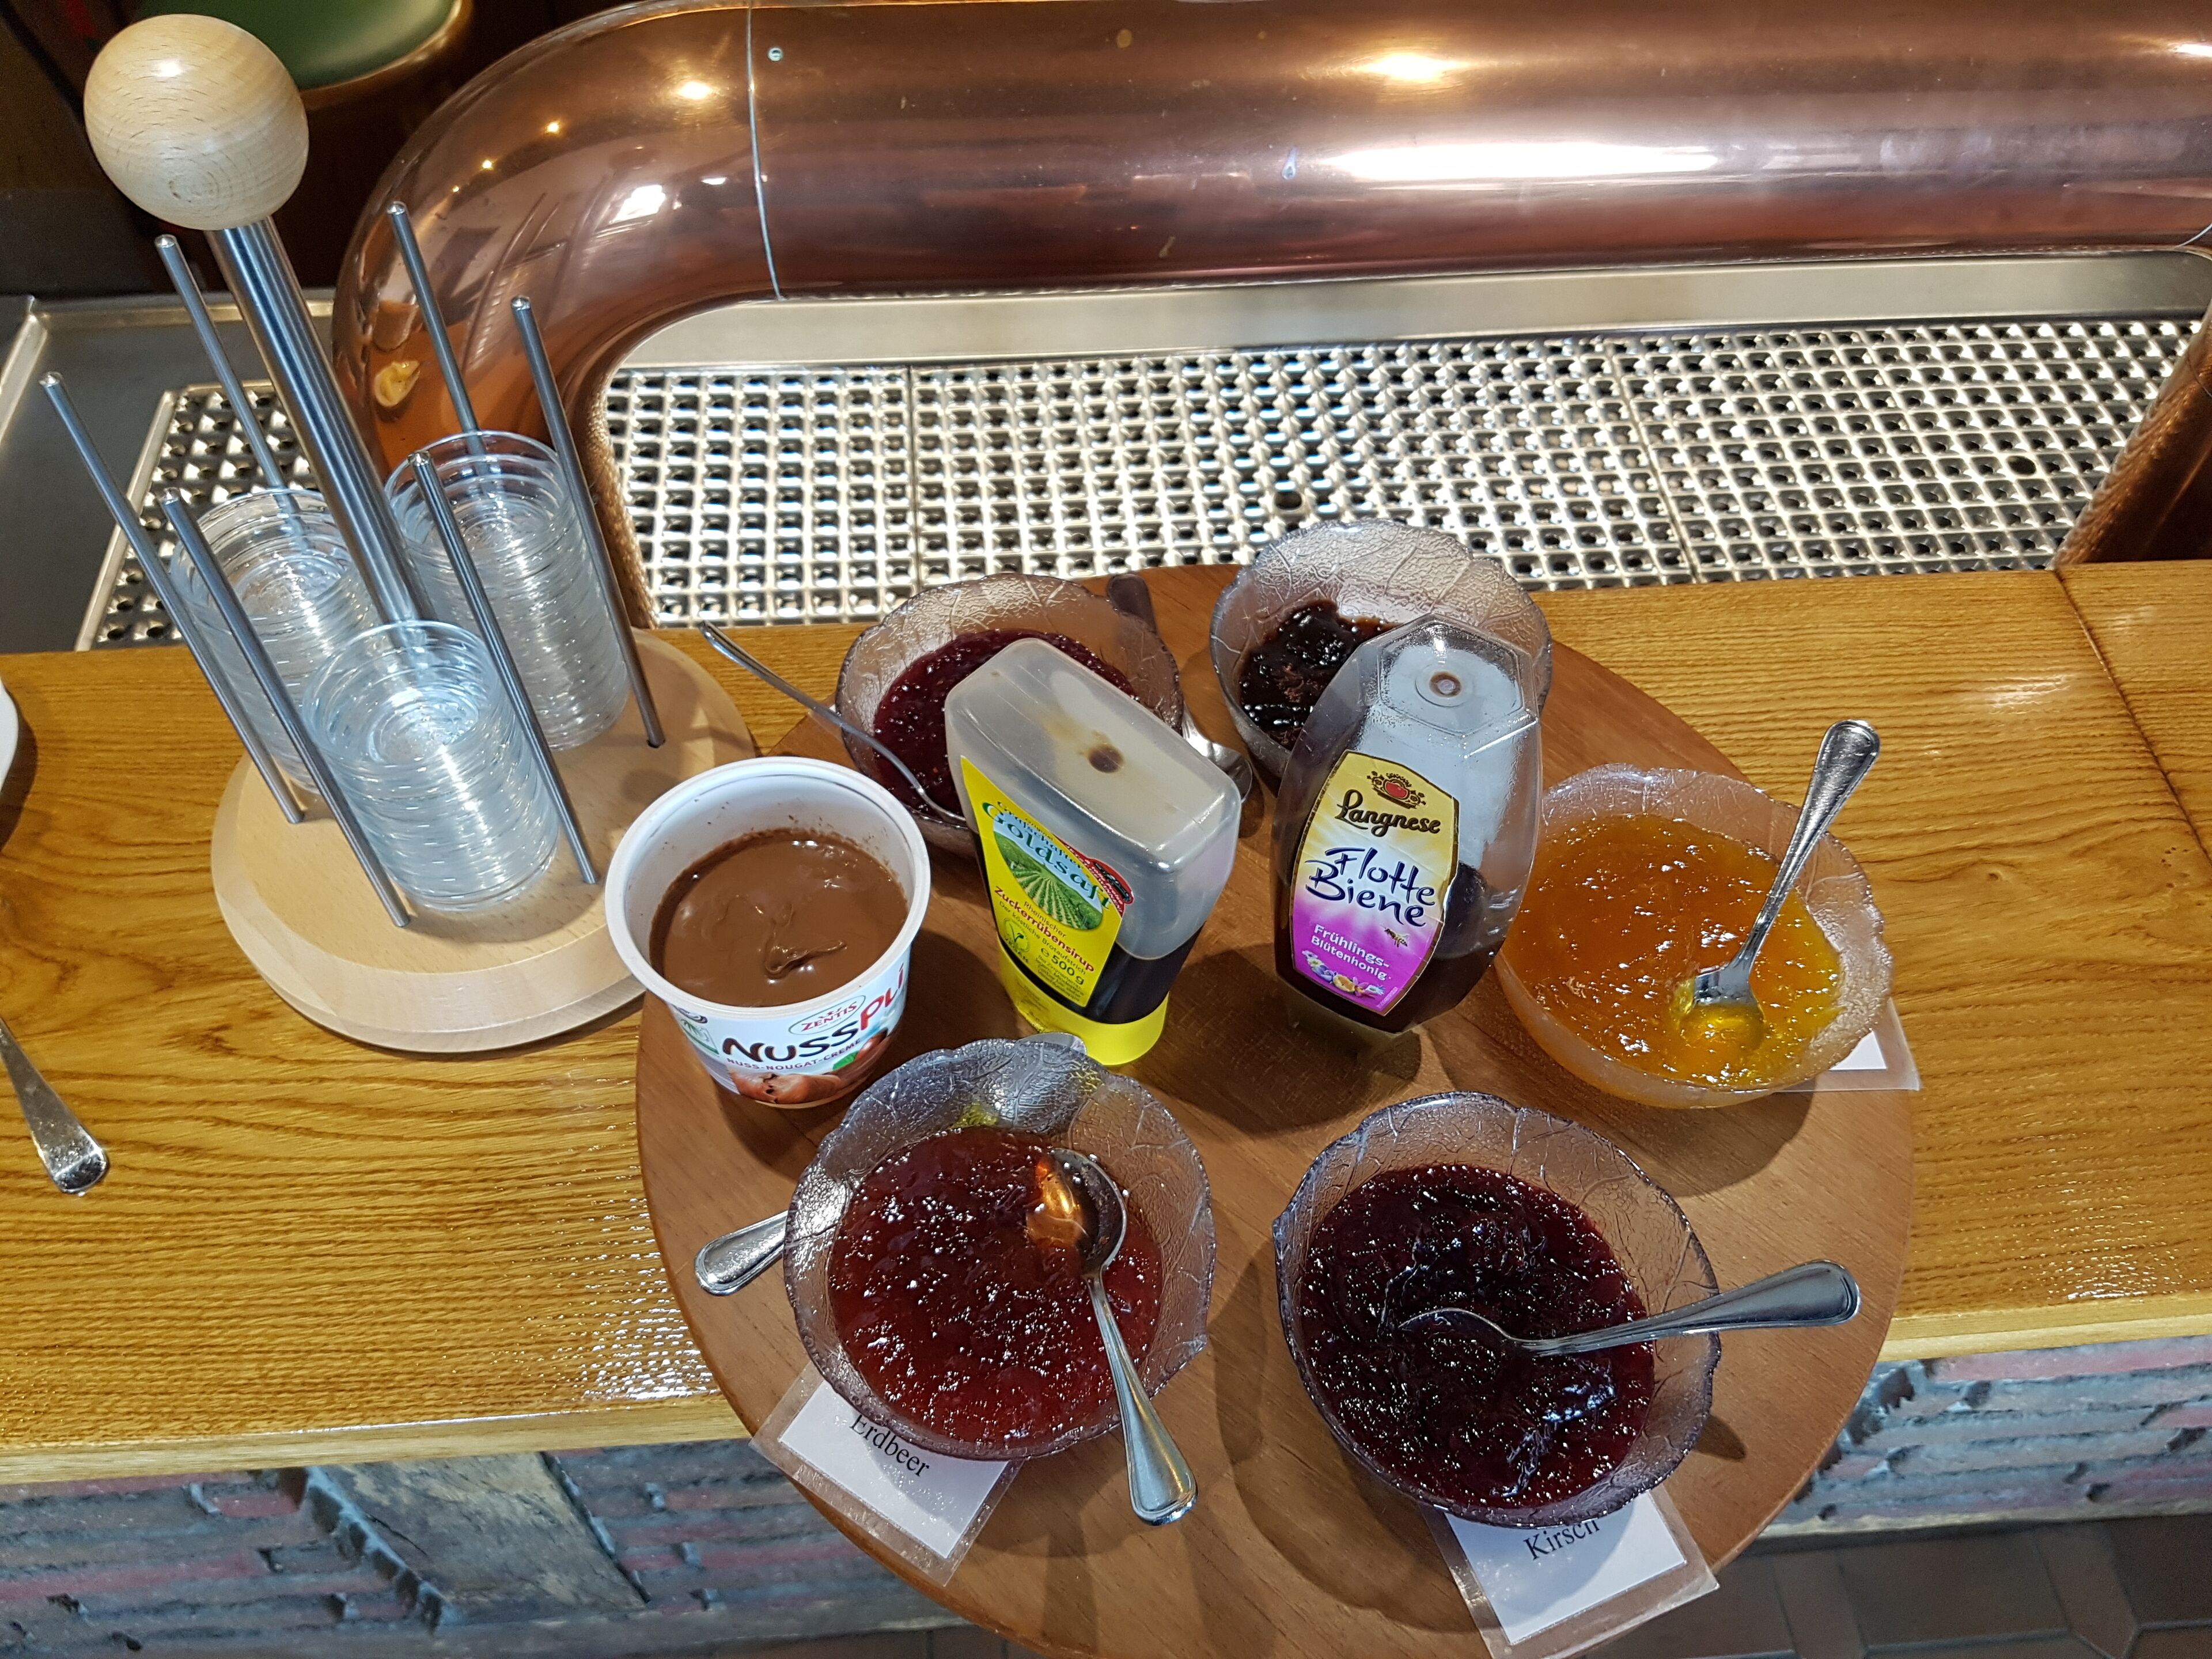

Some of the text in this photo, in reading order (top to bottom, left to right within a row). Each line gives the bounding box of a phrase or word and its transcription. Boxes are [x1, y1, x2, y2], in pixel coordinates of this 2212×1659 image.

[1335, 789, 1441, 837] Langnese
[982, 802, 1111, 910] Goldsaft
[1325, 847, 1435, 906] Flotte
[1305, 860, 1426, 927] Biene
[994, 886, 1094, 972] Zuckerrübensirup
[999, 901, 1086, 975] Der köstliche Brotaufstrich
[1024, 901, 1067, 938] Rheinischer
[1311, 935, 1387, 981] Blütenhonig
[1313, 923, 1389, 968] Frühlings-
[1051, 955, 1075, 976] 500
[1075, 976, 1084, 985] g
[801, 1001, 858, 1031] ZENTIS
[726, 1037, 861, 1070] NUSS-NOUGAT-CREME
[849, 1414, 930, 1477] Erdbeer
